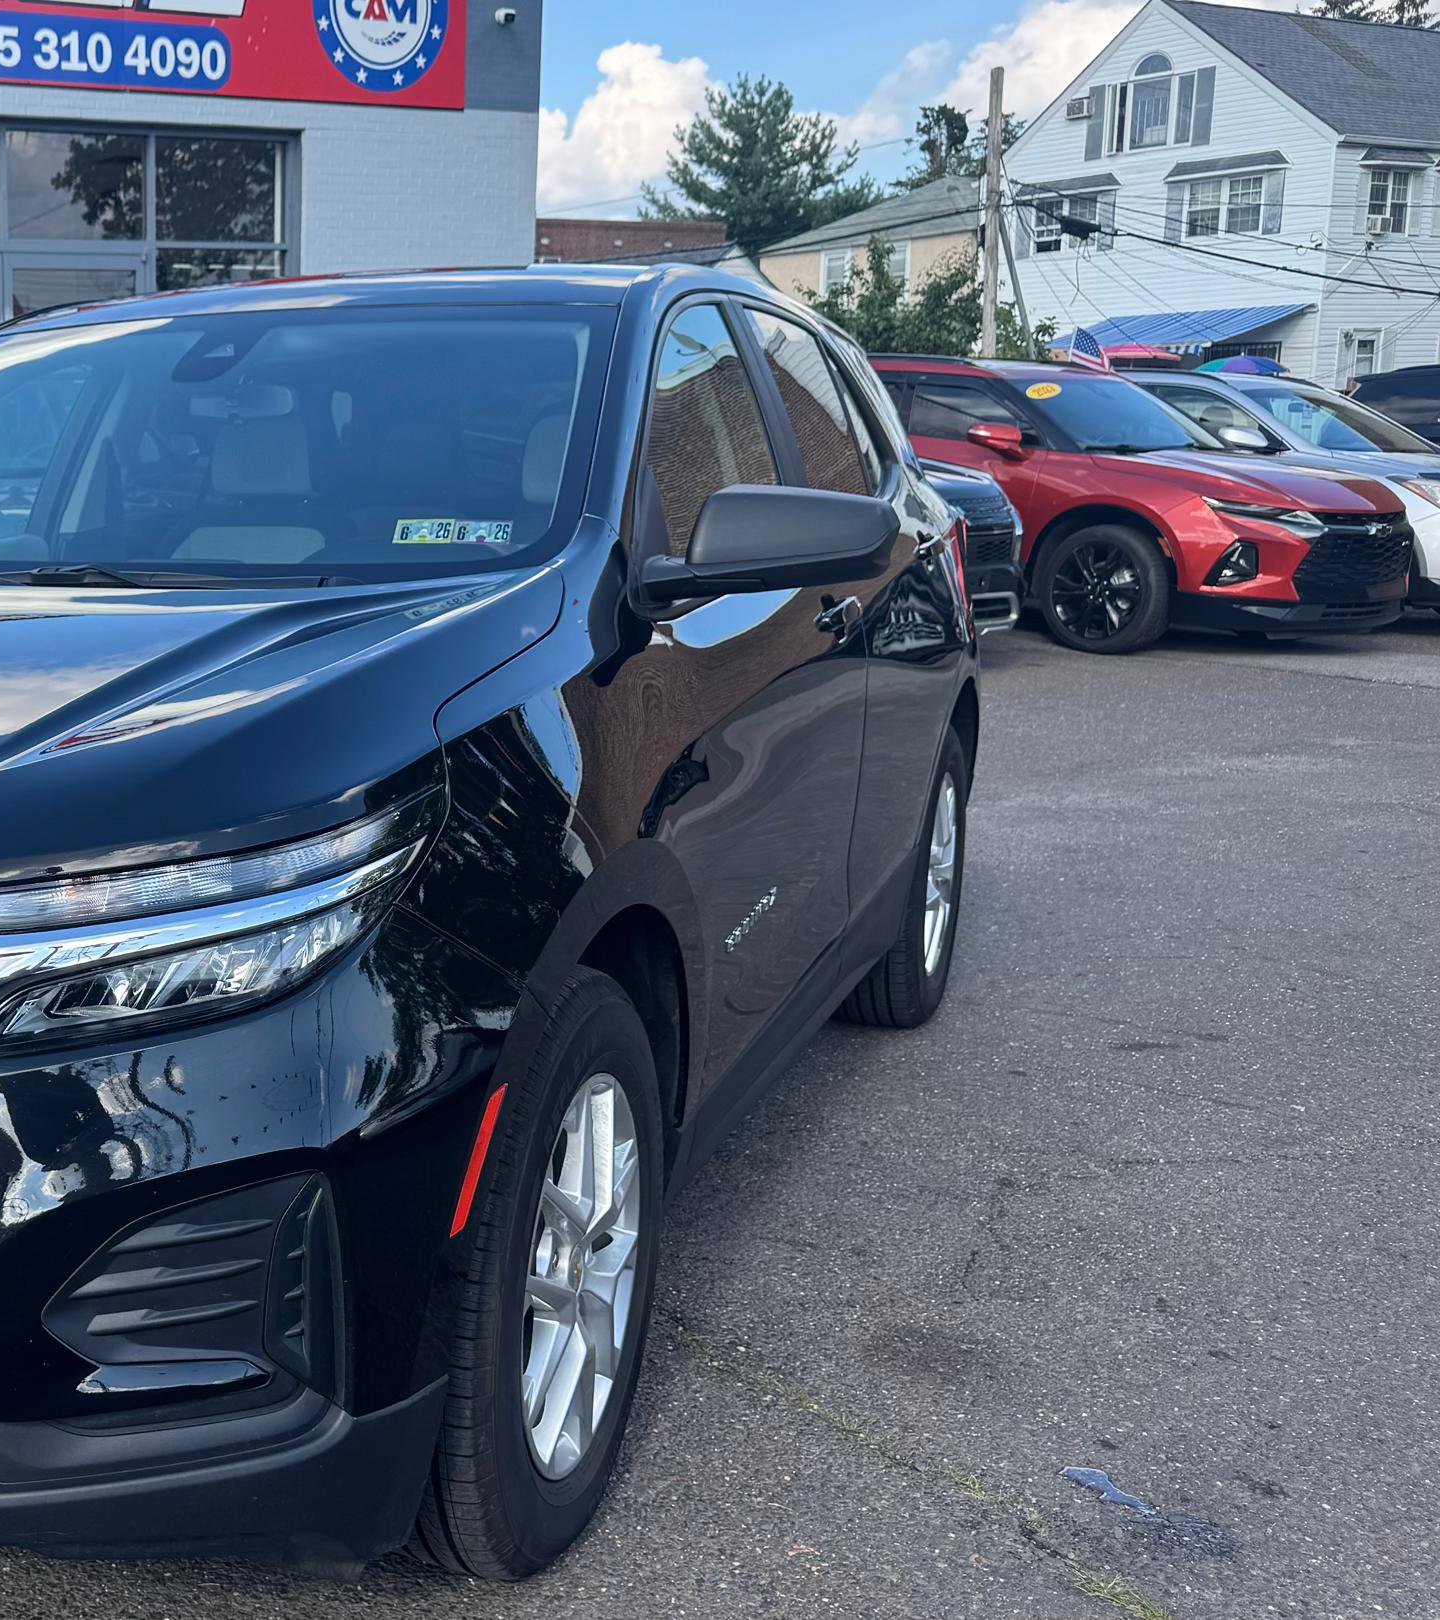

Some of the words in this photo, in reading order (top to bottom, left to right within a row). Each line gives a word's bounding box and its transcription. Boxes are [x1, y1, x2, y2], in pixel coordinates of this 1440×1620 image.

[33, 28, 112, 73] 310
[124, 34, 227, 80] 4090
[435, 522, 452, 539] 26
[494, 523, 510, 540] 26
